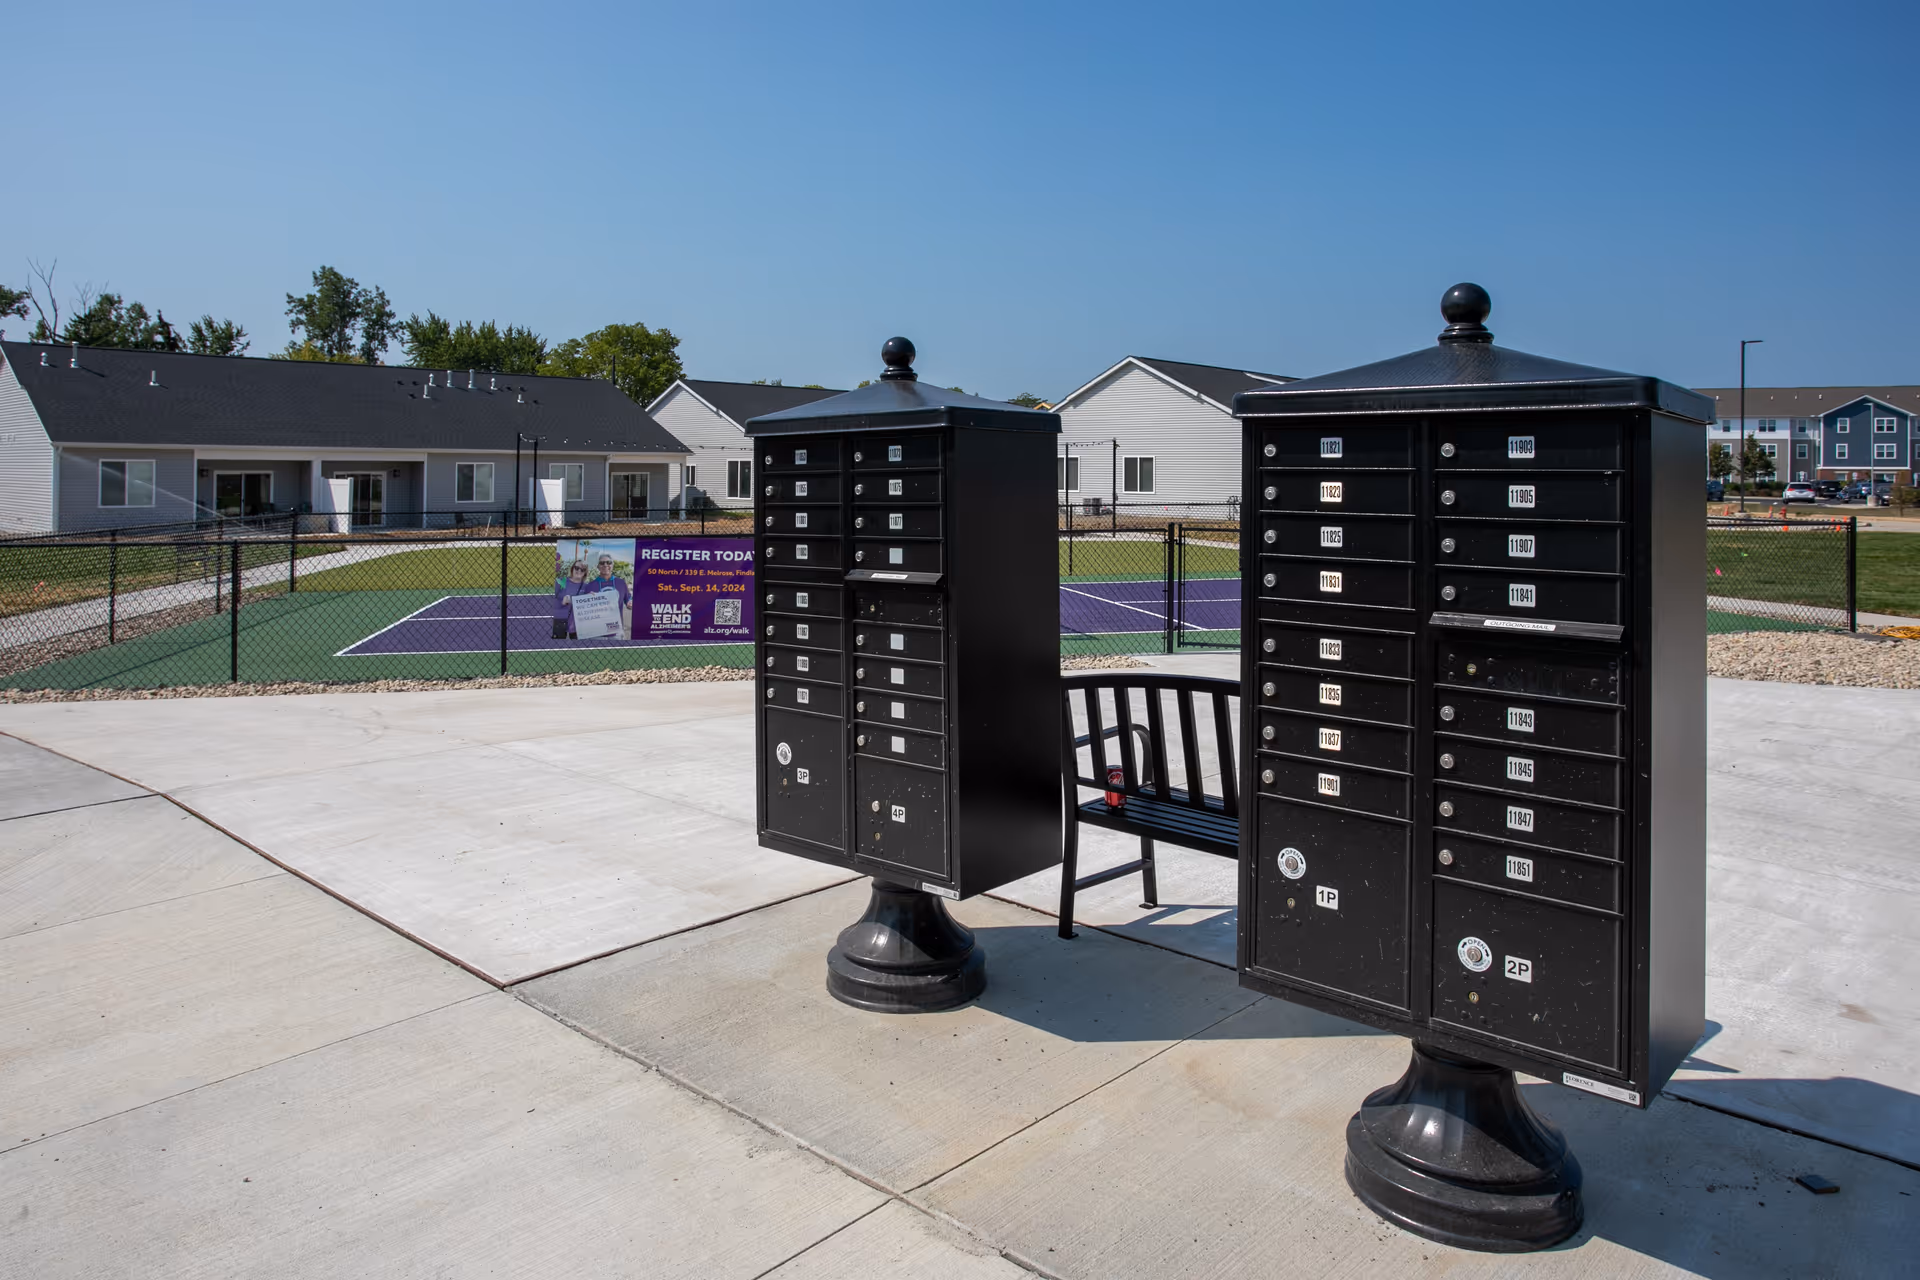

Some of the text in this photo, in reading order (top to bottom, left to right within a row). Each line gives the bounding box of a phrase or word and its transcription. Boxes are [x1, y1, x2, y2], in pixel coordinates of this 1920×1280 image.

[1322, 441, 1340, 454] 11821
[1510, 440, 1533, 454] 11903
[1322, 485, 1341, 498] 11823
[1510, 489, 1533, 503] 11905
[1322, 530, 1341, 543] 11825
[1510, 538, 1533, 553] 11907
[641, 549, 755, 561] REGISTER TODA
[1321, 574, 1340, 588] 11831
[658, 583, 745, 594] Sat., Sept. 14, 2024
[1510, 588, 1532, 603] 11841
[651, 604, 692, 613] WALK
[663, 614, 692, 623] END
[704, 627, 749, 635] alz.org/walk
[1320, 642, 1340, 656] 11833
[1320, 687, 1340, 701] 11835
[1509, 712, 1532, 728] 11843
[1320, 732, 1340, 746] 11837
[799, 770, 808, 780] 3P
[1509, 761, 1532, 778] 11845
[1320, 777, 1338, 792] 11901
[893, 808, 904, 818] 4P
[1508, 810, 1532, 827] 11847
[1285, 850, 1301, 858] OPEN
[1508, 860, 1530, 877] 11851
[1319, 890, 1336, 904] 1P
[1468, 939, 1485, 950] OPEN
[1507, 960, 1529, 976] 2P
[1566, 1075, 1594, 1086] FLORENCE
